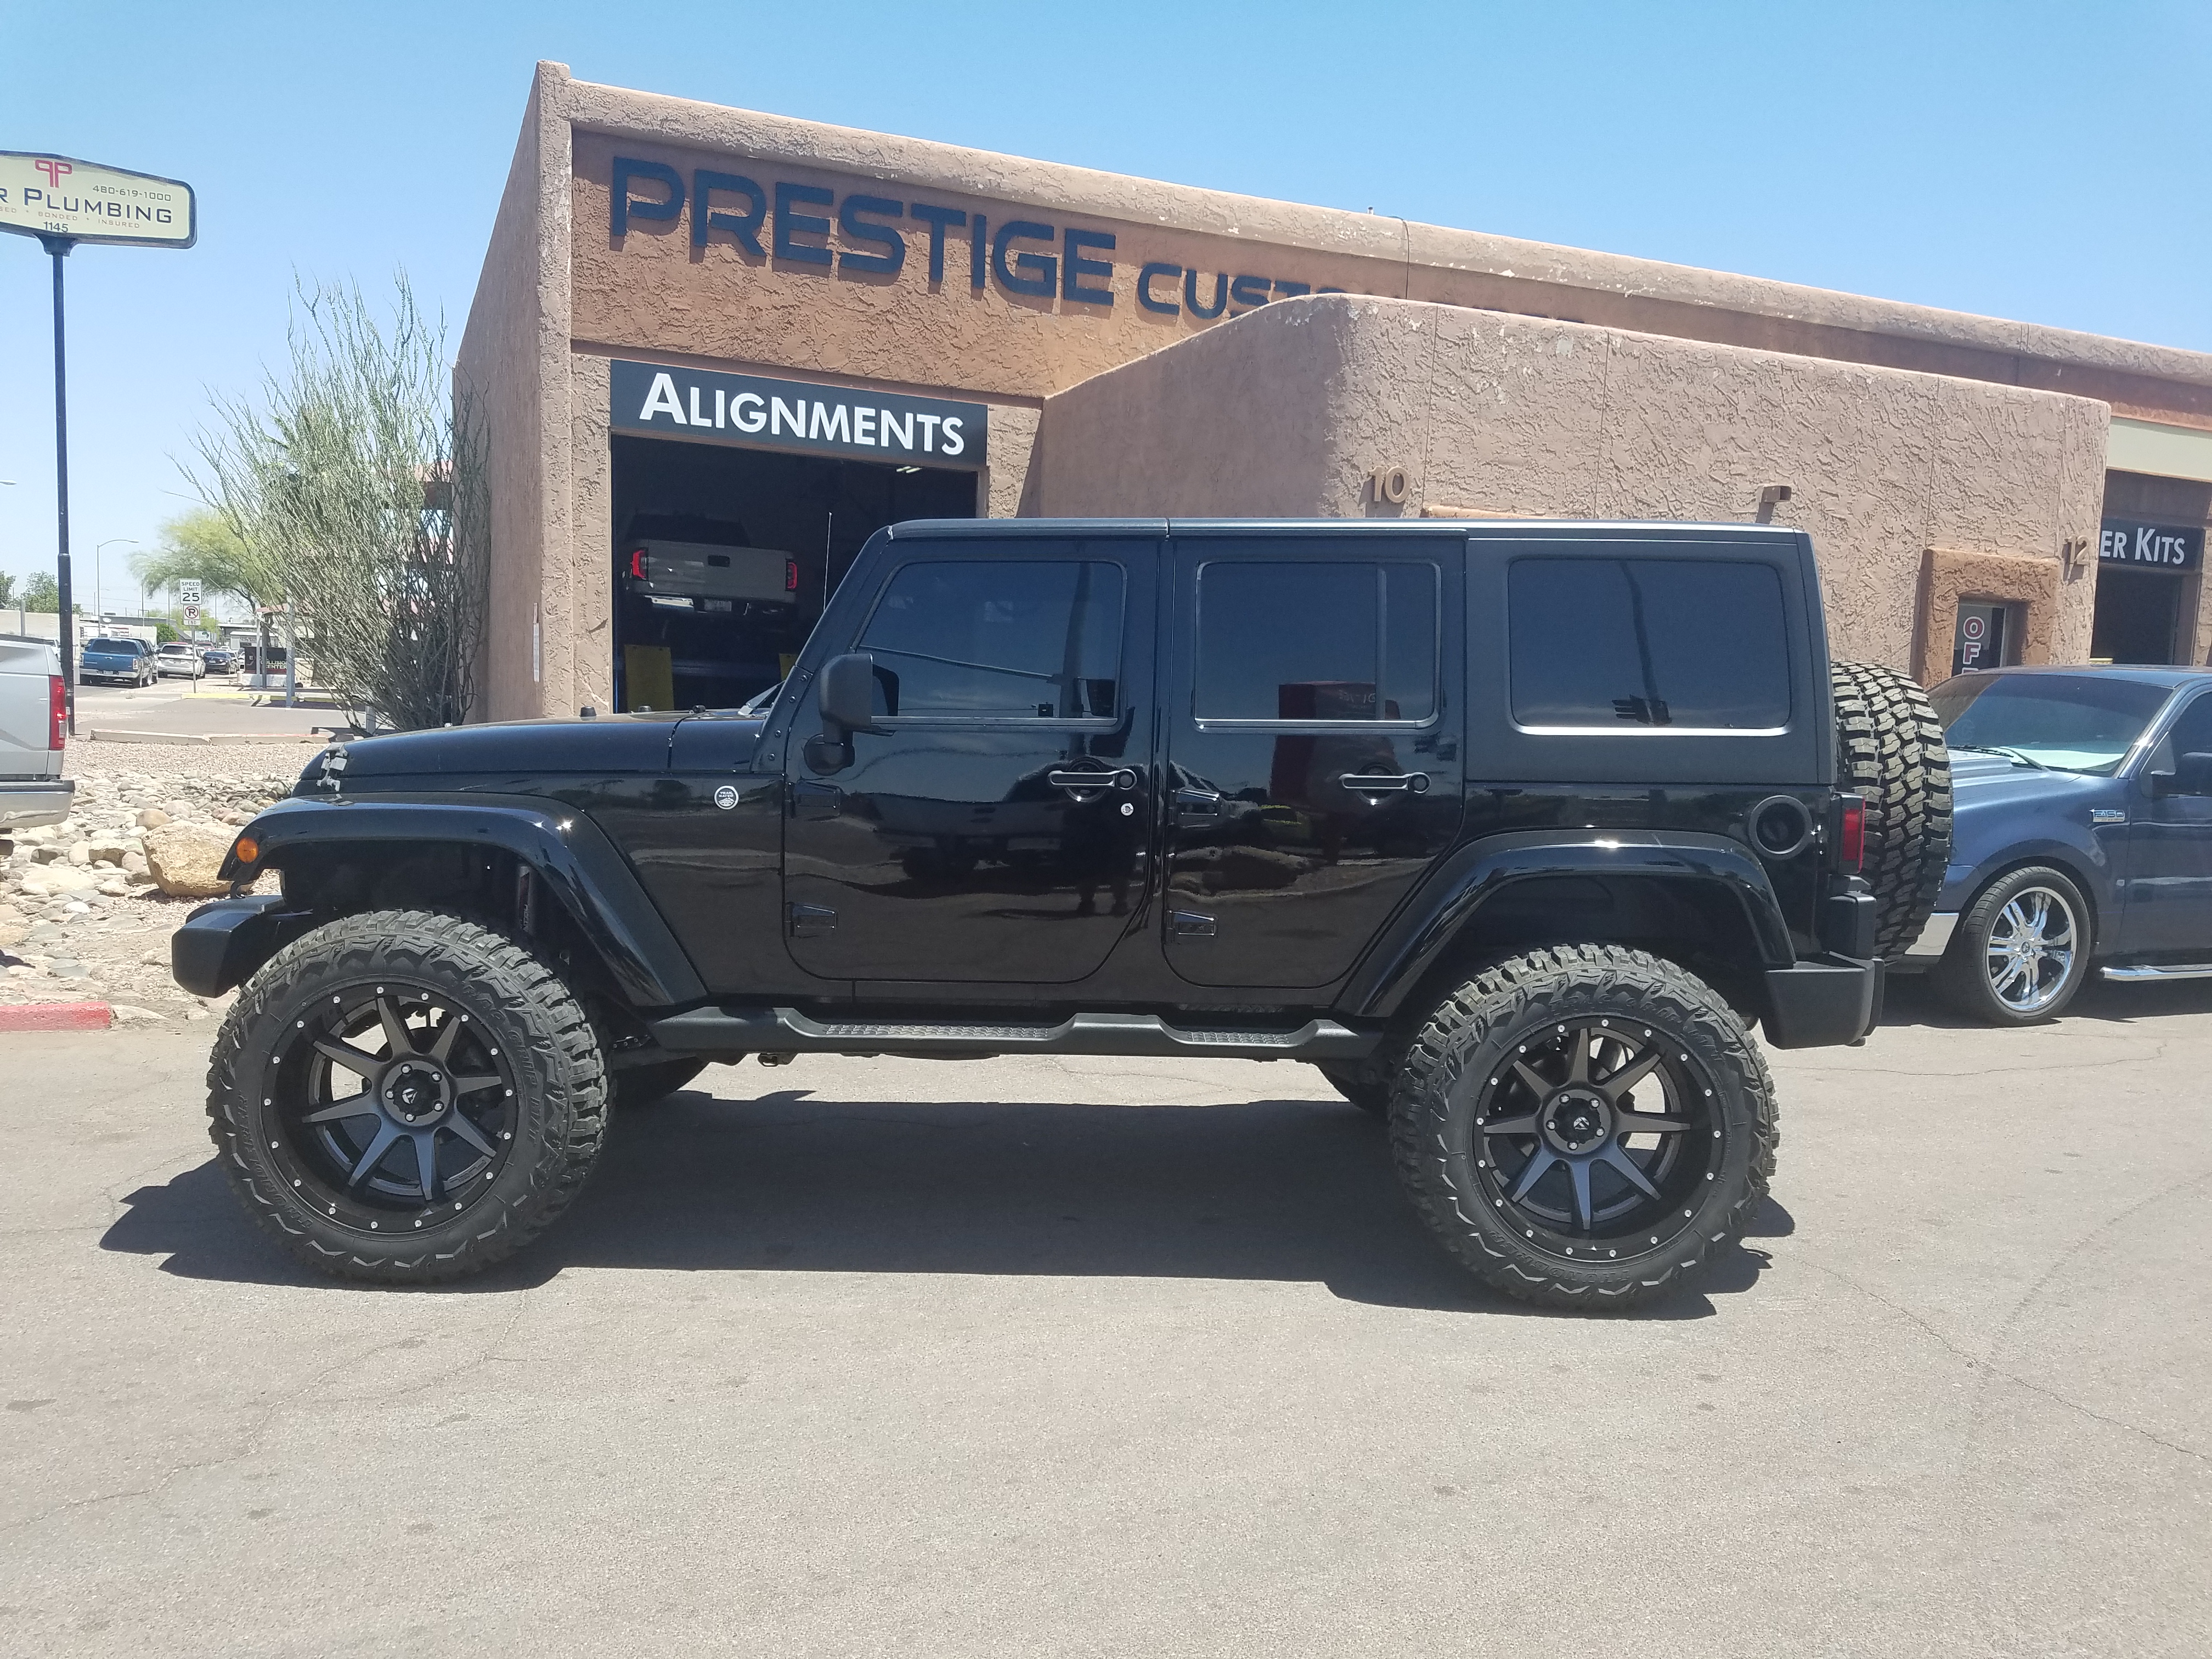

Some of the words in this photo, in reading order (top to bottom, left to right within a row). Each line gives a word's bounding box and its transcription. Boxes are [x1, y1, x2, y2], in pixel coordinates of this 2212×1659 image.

[24, 188, 172, 223] PLUMBING
[92, 185, 171, 201] 480-619-1000
[38, 211, 78, 221] BONDED
[98, 219, 140, 228] INSURED
[43, 221, 69, 233] 1145
[611, 156, 1116, 307] PRESTIGE
[1137, 263, 1348, 320] CUS
[639, 373, 964, 456] ALIGNMENTS
[1368, 466, 1412, 503] 10
[2065, 534, 2091, 566] 12
[2135, 527, 2186, 565] KITS
[182, 592, 200, 601] 25
[1962, 616, 1985, 674] OF
